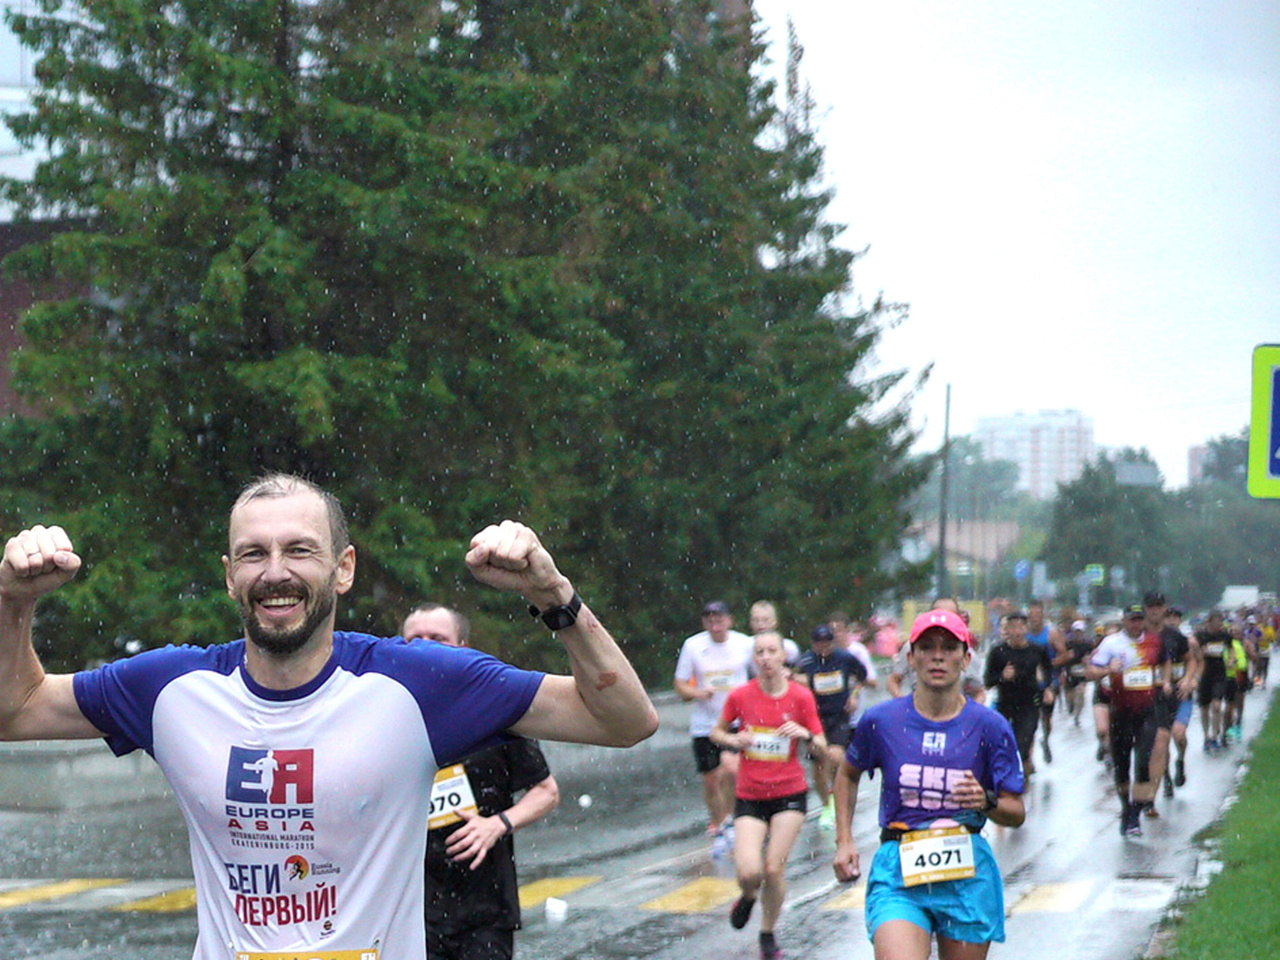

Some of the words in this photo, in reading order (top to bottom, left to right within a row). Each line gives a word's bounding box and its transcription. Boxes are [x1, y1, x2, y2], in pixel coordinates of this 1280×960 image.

[225, 805, 314, 819] EUROPE
[228, 818, 315, 832] ASIA
[229, 831, 279, 841] INTERNATIONAL
[280, 834, 315, 842] MARATHON
[915, 849, 962, 868] 4071
[224, 863, 281, 895] БЕГИ
[235, 882, 337, 927] ПЕРВЫЙ!
